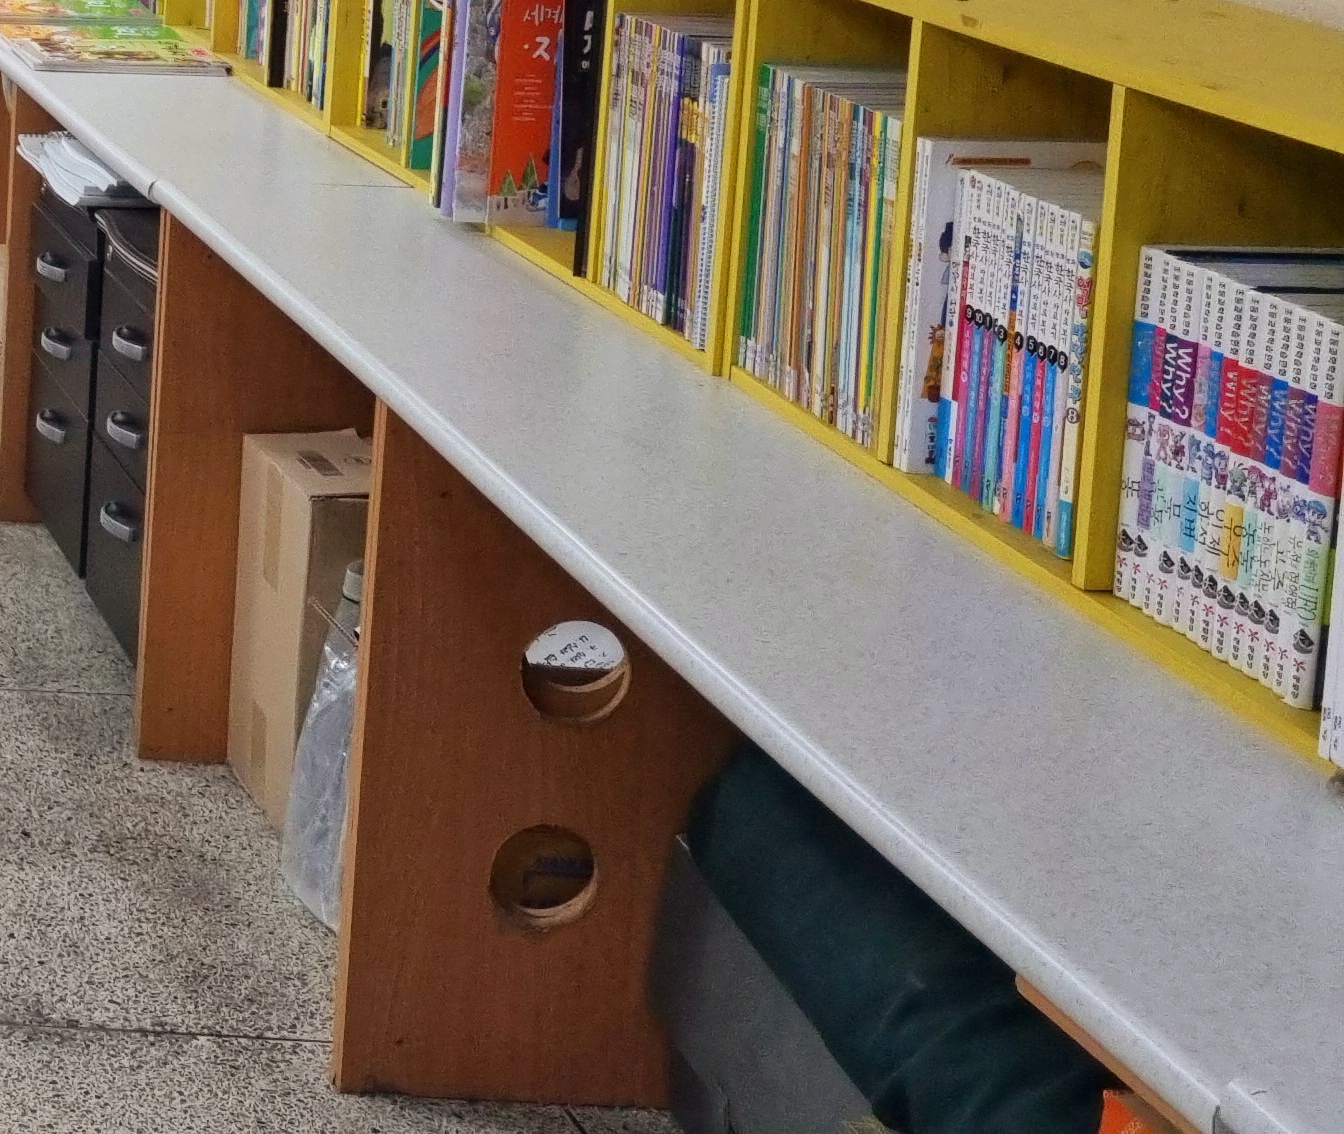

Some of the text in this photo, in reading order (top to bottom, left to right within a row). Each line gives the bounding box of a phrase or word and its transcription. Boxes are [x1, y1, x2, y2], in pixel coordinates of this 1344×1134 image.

[965, 309, 973, 320] 9
[974, 313, 983, 324] 10
[985, 317, 991, 327] 1
[998, 329, 1005, 339] 3
[1015, 337, 1022, 347] 4
[1027, 340, 1035, 349] 5
[1038, 347, 1045, 356] 6
[1049, 349, 1055, 359] 7
[1059, 357, 1066, 366] 8
[1160, 343, 1179, 413] Why?
[1173, 347, 1194, 419] Why?
[1220, 518, 1247, 567] 우주
